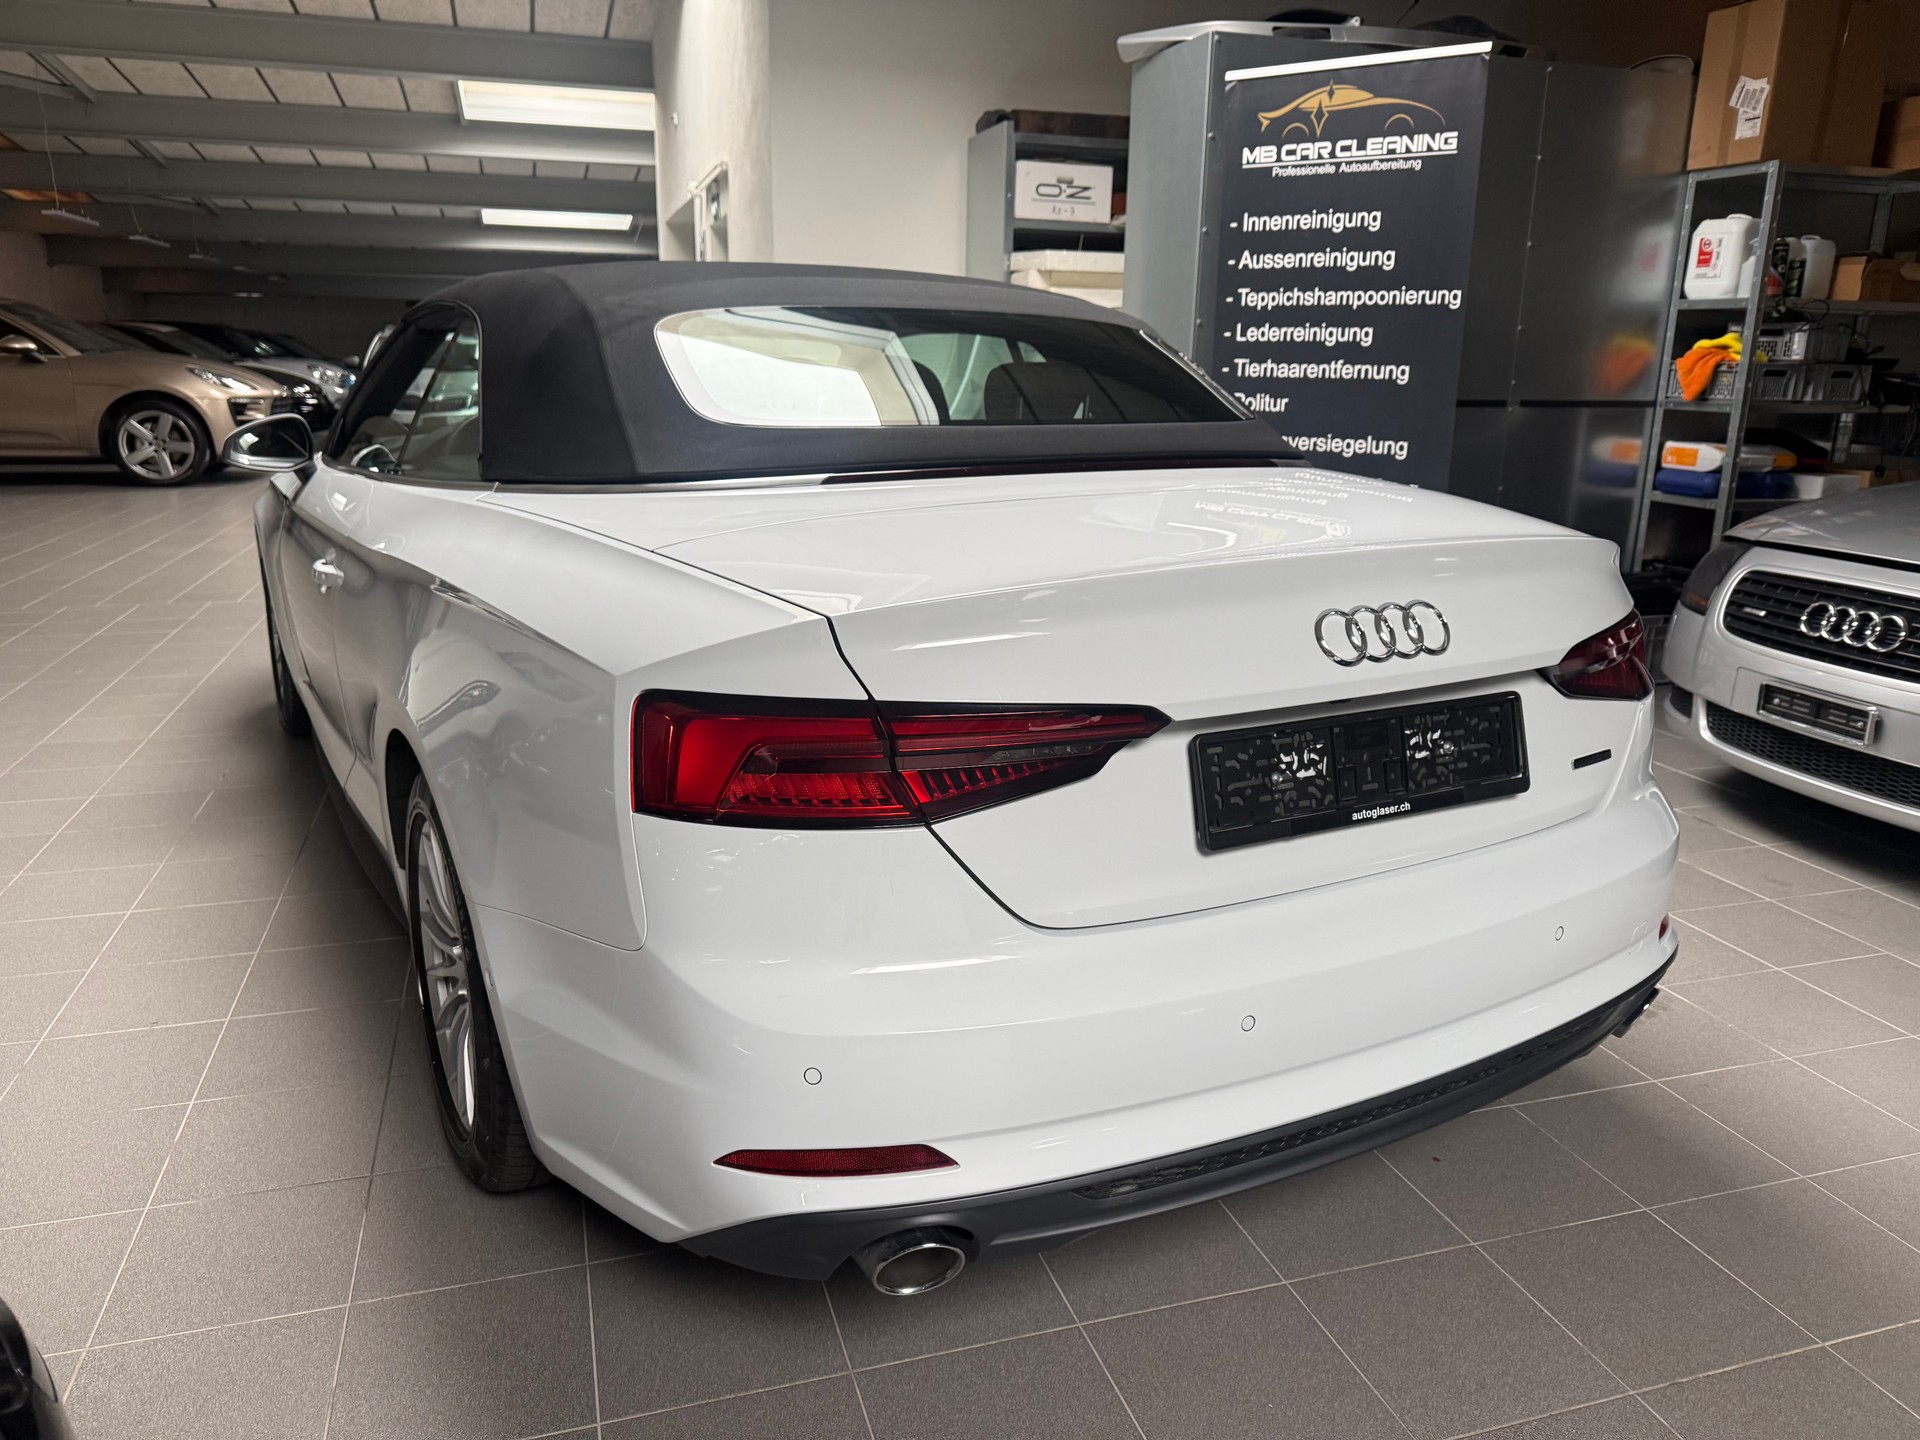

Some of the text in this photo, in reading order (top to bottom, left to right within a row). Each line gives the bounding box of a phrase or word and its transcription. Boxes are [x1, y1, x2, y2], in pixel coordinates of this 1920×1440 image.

[1242, 131, 1459, 165] MB CAR CLEANING
[1272, 158, 1422, 178] Professionelle Autoaufbereitung
[1243, 208, 1382, 233] Innenreinigung
[1238, 247, 1396, 271] Aussenreinigung
[1238, 285, 1462, 310] Teppichshampoonierung
[1235, 322, 1374, 346] Lederreinigung
[1233, 358, 1410, 385] Tierhaarentfernung
[1281, 433, 1409, 460] versiegelung
[1352, 801, 1411, 821] autoglaser.ch
